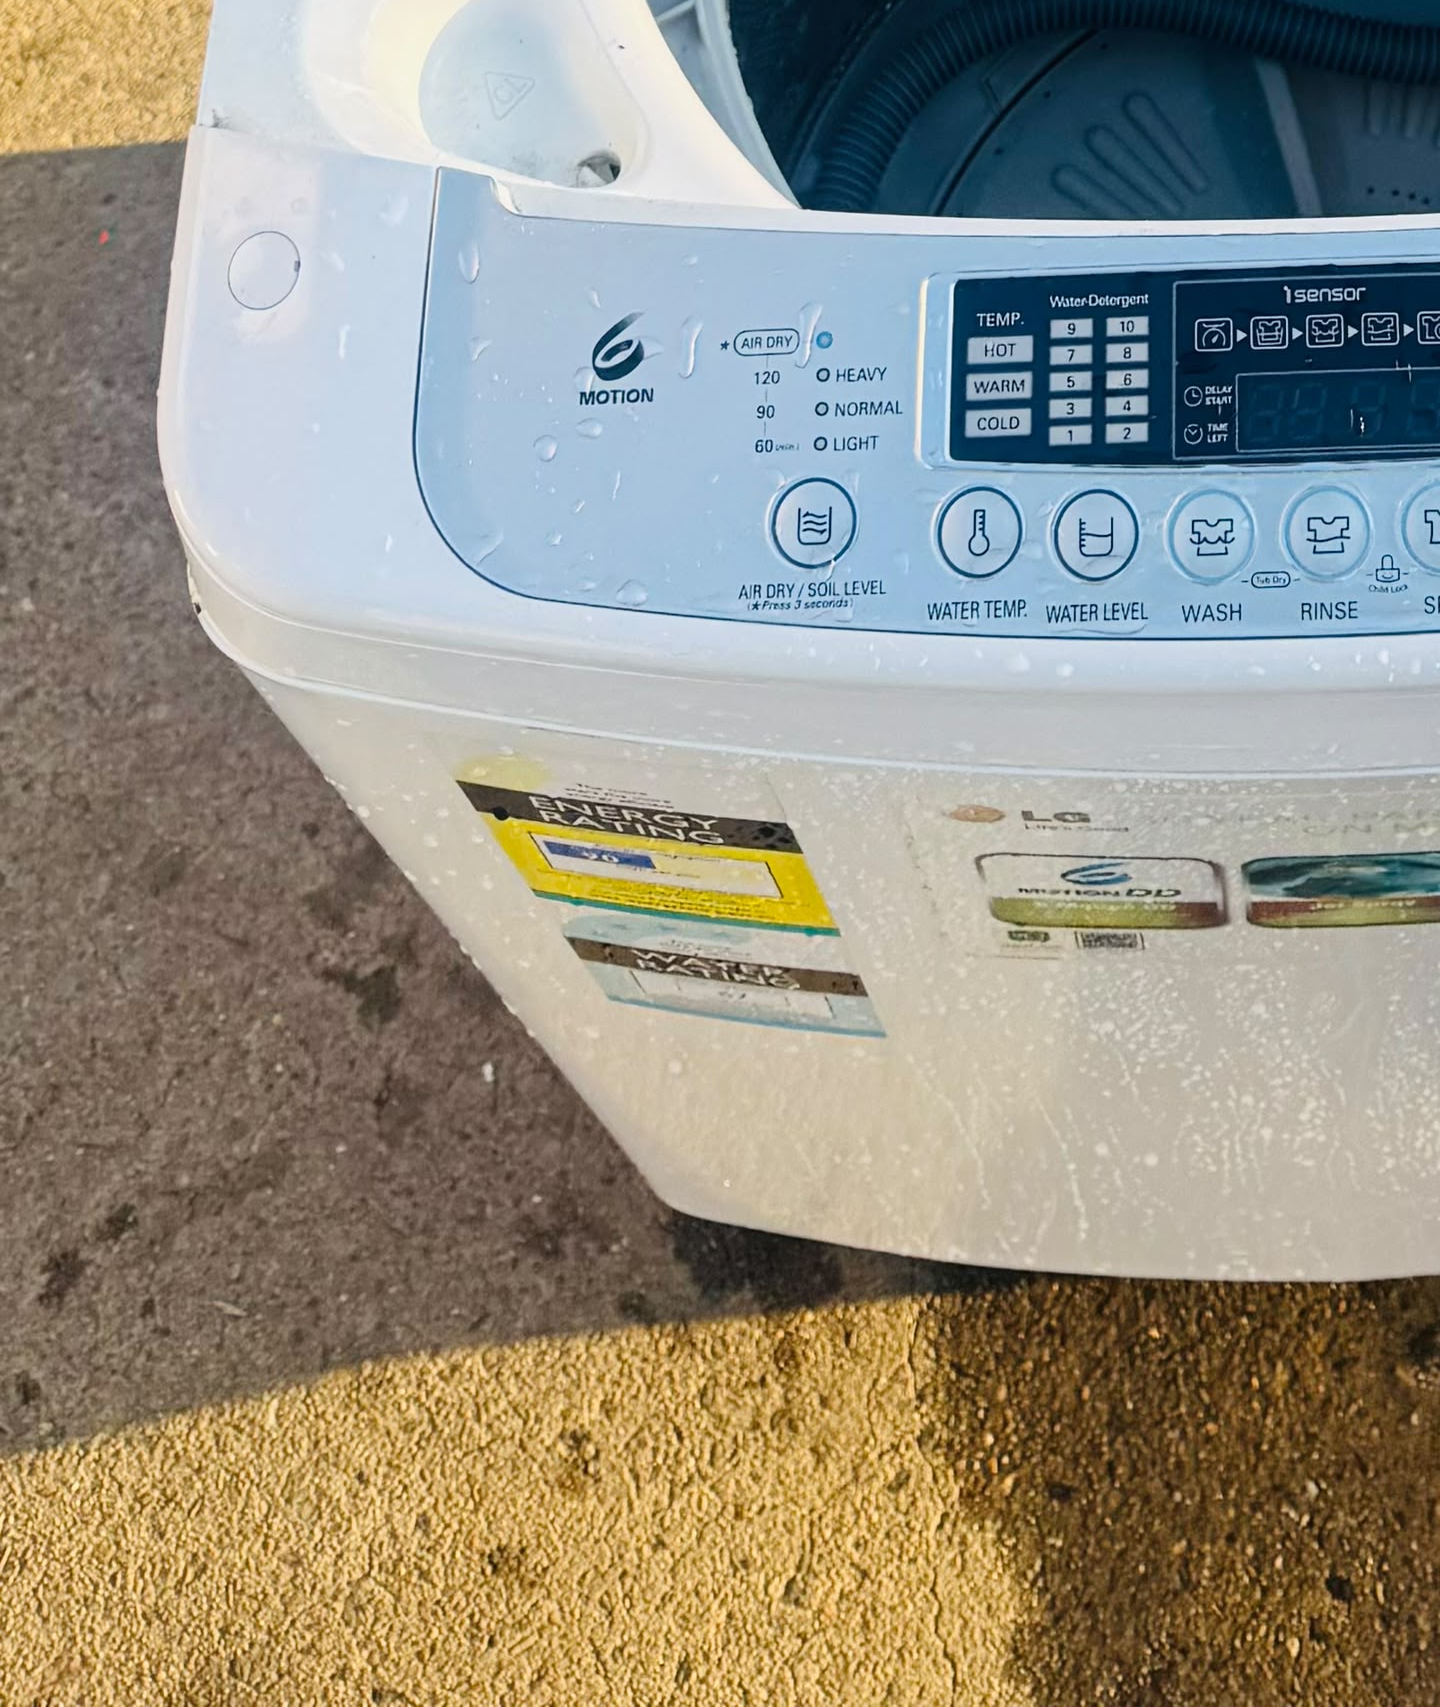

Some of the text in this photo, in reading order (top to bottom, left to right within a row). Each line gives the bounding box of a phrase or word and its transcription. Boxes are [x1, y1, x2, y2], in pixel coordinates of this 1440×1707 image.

[976, 312, 1025, 327] TEMP.
[1119, 320, 1135, 333] 10
[1067, 323, 1076, 335] 9
[741, 335, 793, 350] AIR DRY
[984, 343, 1016, 358] HOT
[1067, 349, 1075, 362] 7
[1123, 346, 1131, 360] 8
[754, 370, 781, 385] 120
[836, 367, 887, 383] HEAVY
[1067, 376, 1075, 389] 5
[1123, 373, 1132, 387] 6
[973, 378, 1025, 394] WARM
[579, 387, 654, 405] MOTION
[756, 405, 775, 419] 90
[834, 400, 903, 417] NORMAL
[1066, 402, 1075, 415] 3
[1123, 399, 1132, 413] 4
[977, 416, 1020, 431] COLD
[1123, 427, 1131, 440] 2
[755, 439, 773, 453] 60
[833, 435, 879, 452] LIGHT
[738, 583, 761, 599] AIR
[766, 583, 795, 598] DRY
[808, 581, 840, 597] SOIL
[845, 580, 887, 595] LEVEL
[926, 599, 1028, 622] WATER TEMP.
[1046, 602, 1149, 624] WATER LEVEL
[1181, 603, 1242, 623] WASH
[1301, 601, 1358, 621] RINSE
[528, 795, 718, 830] ENERGY
[1021, 811, 1091, 823] LG
[539, 810, 724, 844] RATING
[1126, 888, 1181, 898] DD
